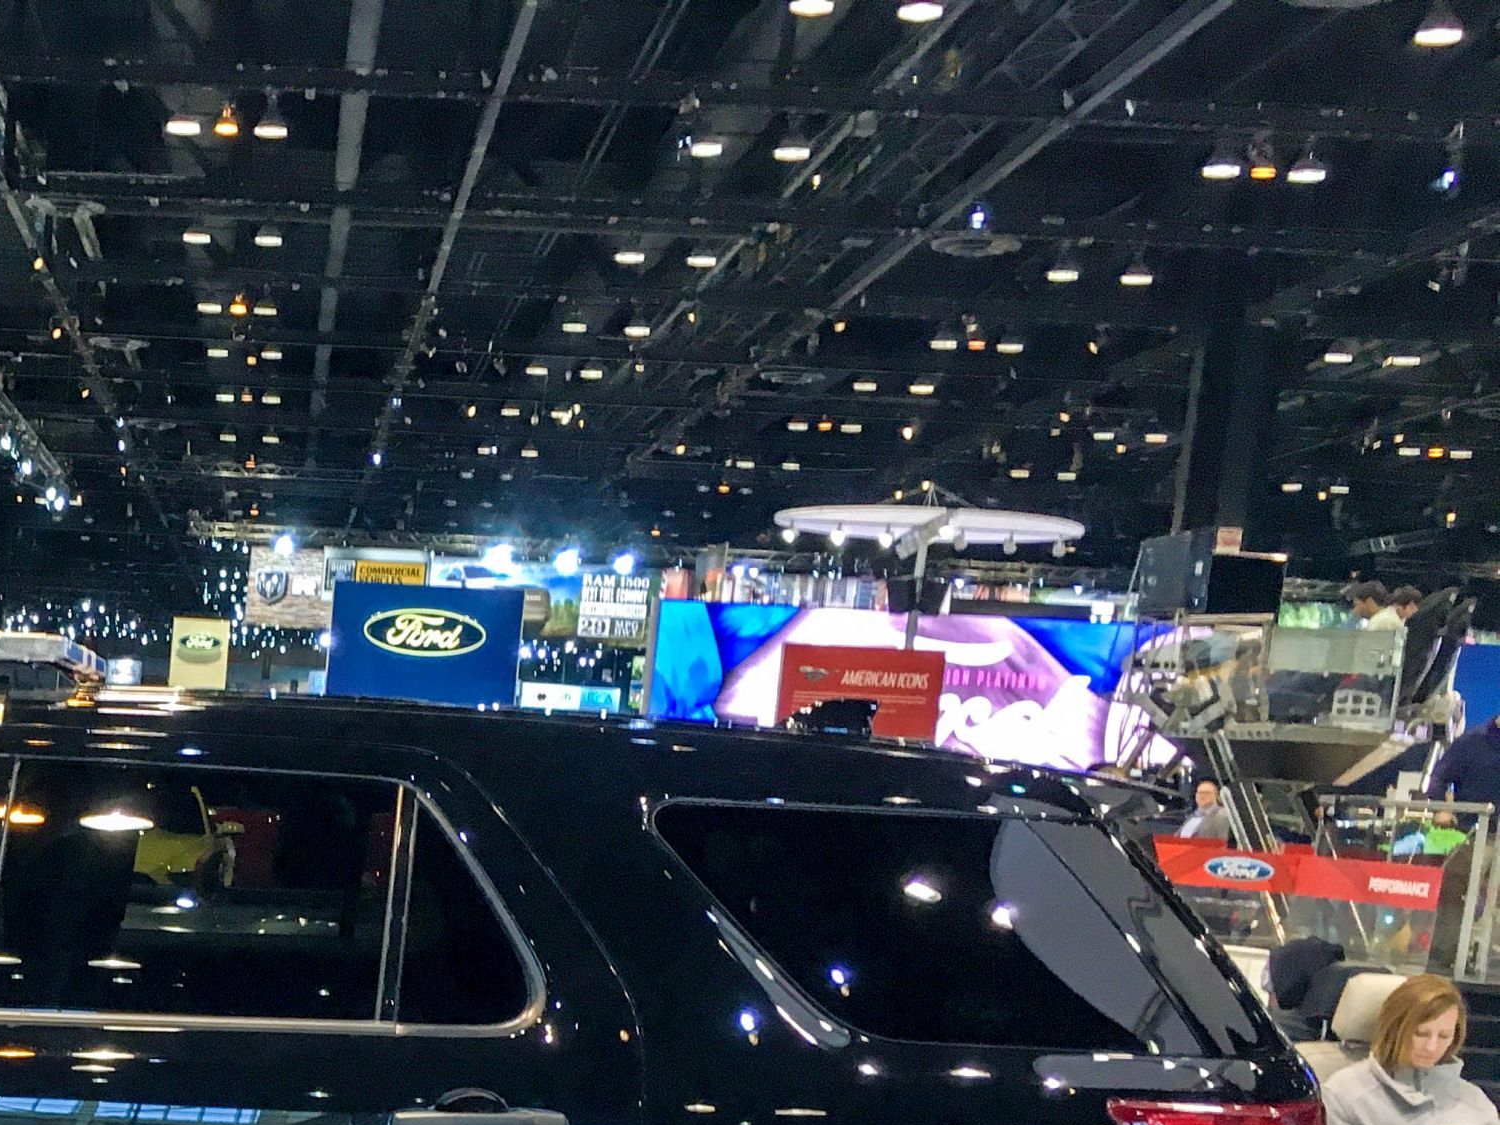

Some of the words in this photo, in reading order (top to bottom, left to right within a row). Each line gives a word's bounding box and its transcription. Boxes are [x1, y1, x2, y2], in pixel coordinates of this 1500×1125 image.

[359, 564, 422, 578] COMMERCIAL
[582, 573, 616, 588] RAM
[386, 613, 462, 649] Ford
[186, 632, 214, 650] Ford
[841, 670, 895, 687] AMERICAN
[897, 672, 929, 689] ICONS
[1217, 862, 1260, 880] Ford
[1368, 876, 1430, 898] PERFORMANCE
